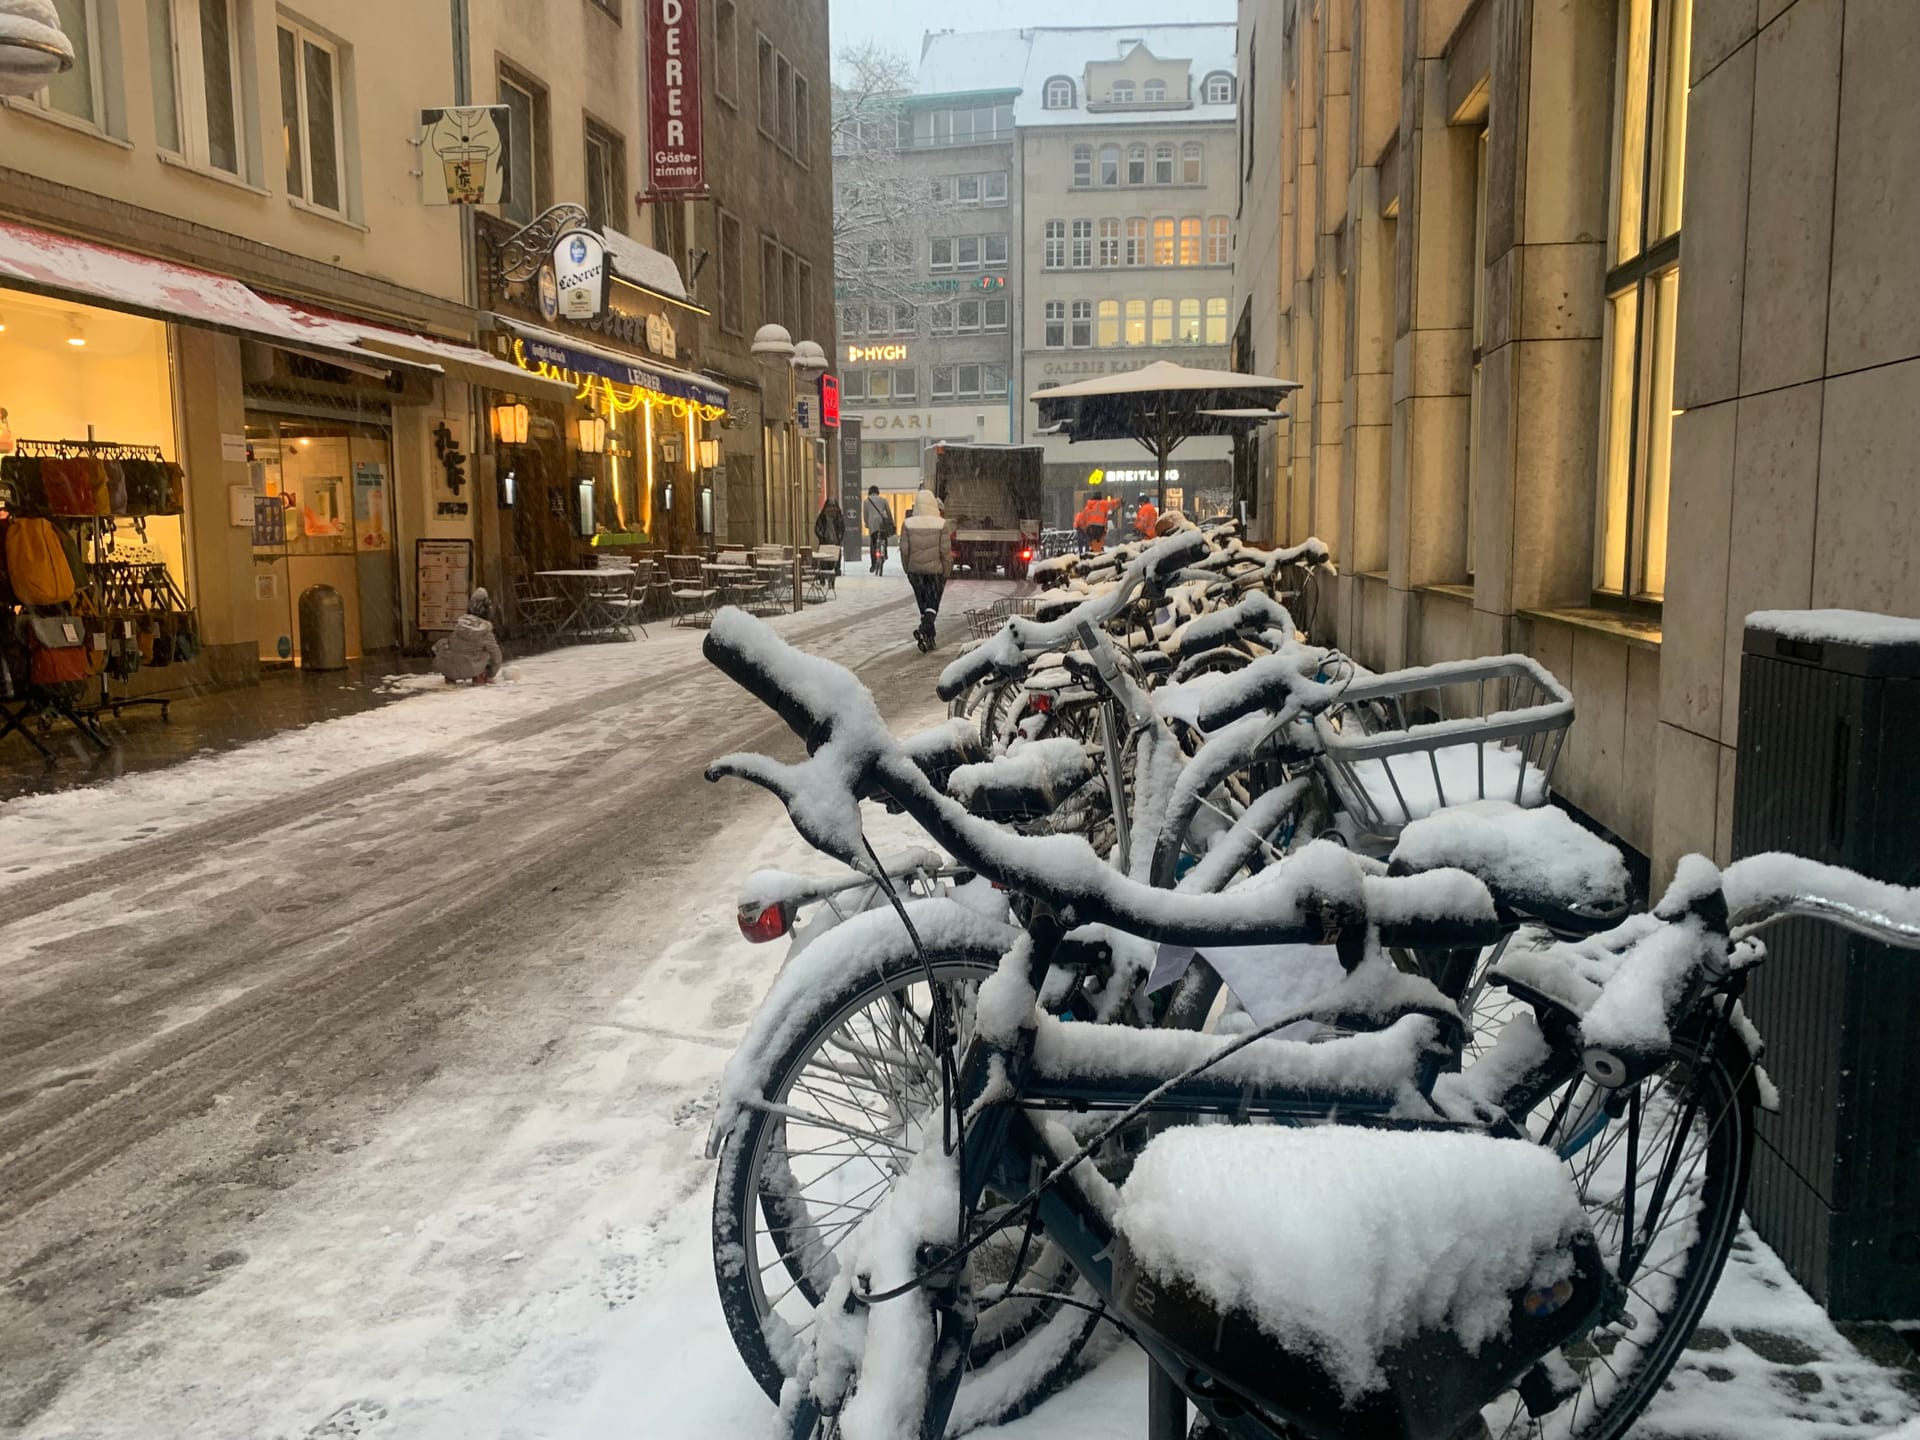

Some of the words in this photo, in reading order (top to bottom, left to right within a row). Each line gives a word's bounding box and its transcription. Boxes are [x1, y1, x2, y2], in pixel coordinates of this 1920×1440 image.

[655, 150, 697, 164] Gäste-
[655, 164, 698, 177] zimmer
[558, 264, 602, 291] Lederer
[864, 345, 907, 361] HYGH
[1043, 361, 1105, 375] GALERIE
[627, 368, 662, 391] LEDERER
